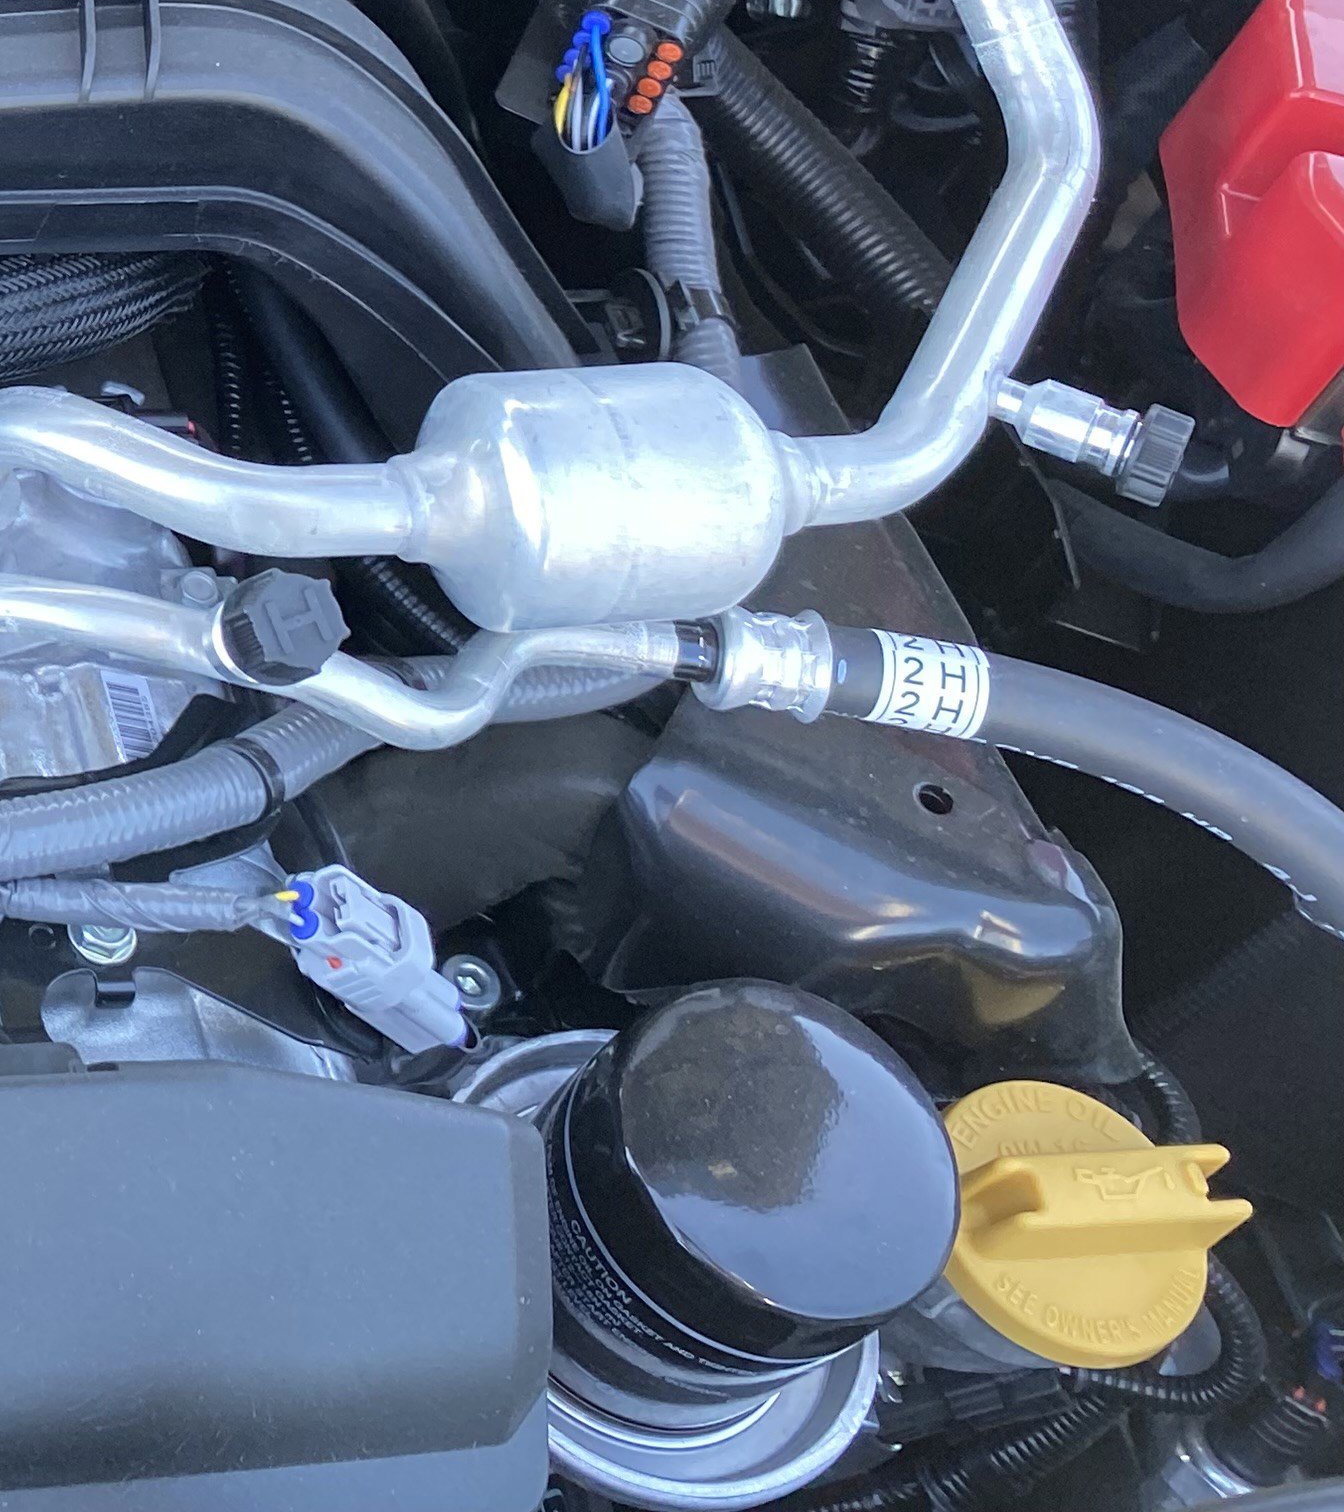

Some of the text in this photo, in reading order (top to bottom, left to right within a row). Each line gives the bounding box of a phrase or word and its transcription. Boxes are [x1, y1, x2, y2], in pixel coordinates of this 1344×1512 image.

[264, 588, 333, 655] H
[951, 1088, 1120, 1152] ENGINE OIL
[569, 1217, 632, 1306] CAUTION
[994, 1268, 1202, 1345] SEE OWNER'S MANUAL
